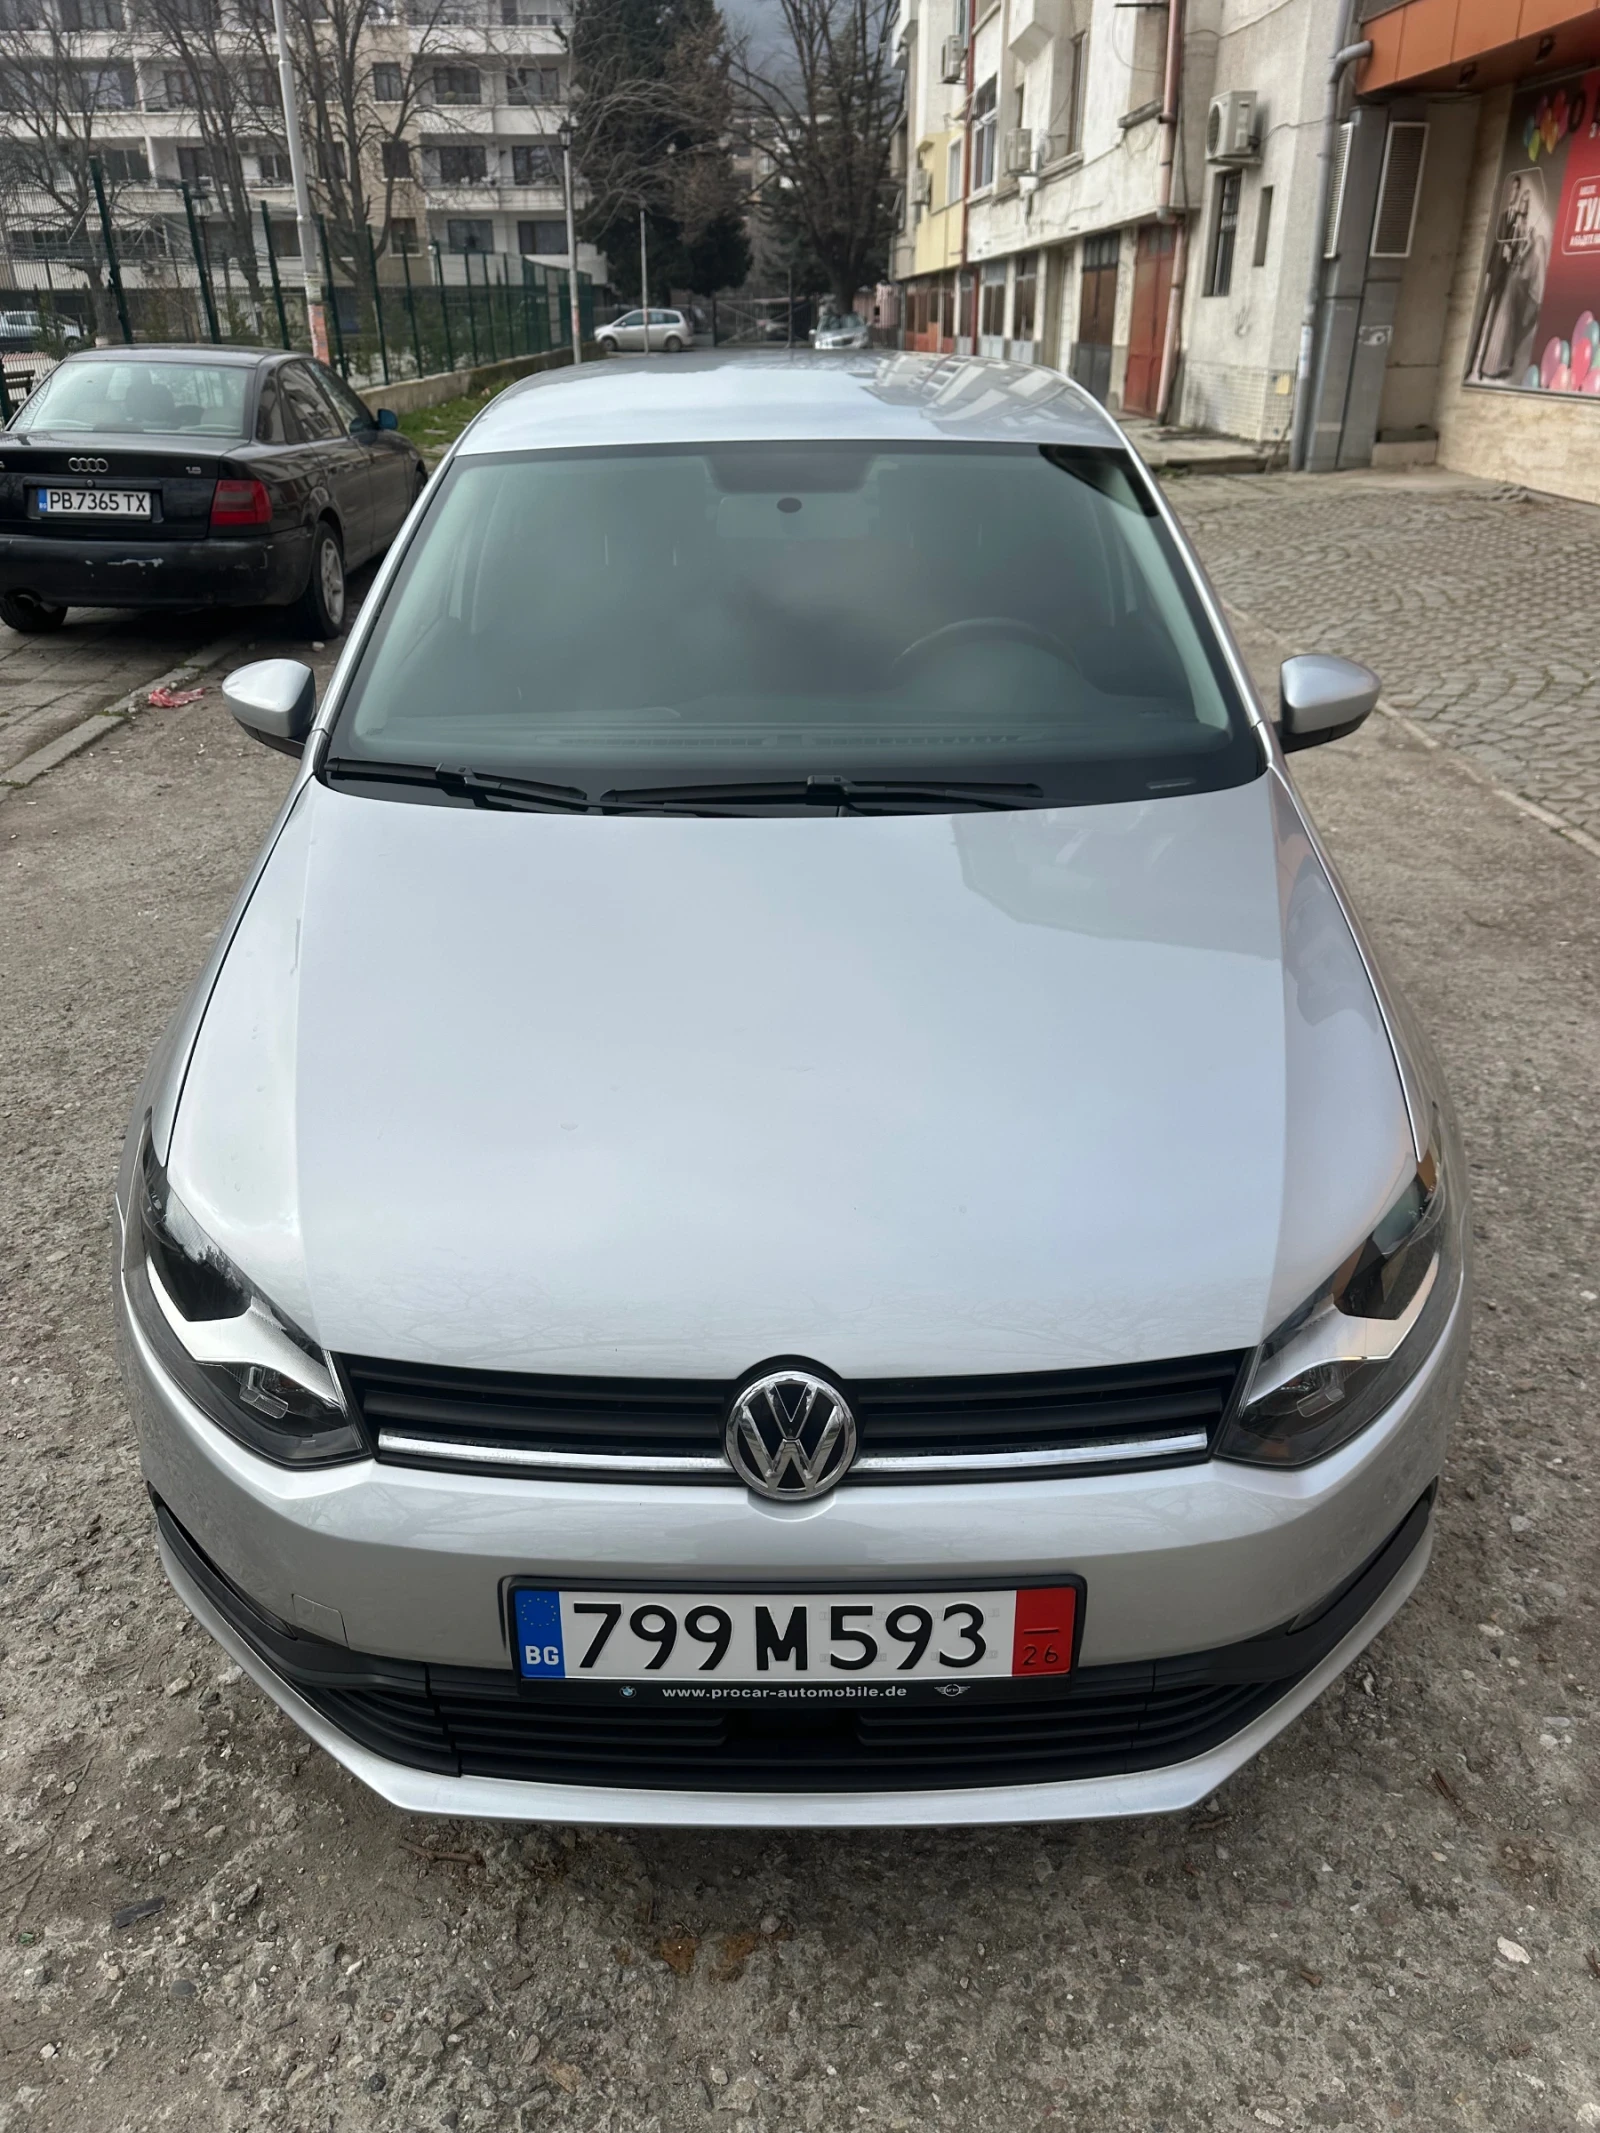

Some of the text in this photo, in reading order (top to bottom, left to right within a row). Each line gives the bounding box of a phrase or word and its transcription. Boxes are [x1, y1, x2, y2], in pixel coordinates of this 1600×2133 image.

[76, 493, 119, 511] 7365
[122, 494, 146, 512] TX
[573, 1602, 987, 1671] 799 M 593
[525, 1645, 560, 1665] BG
[1022, 1644, 1060, 1666] 26
[662, 1685, 908, 1700] www.procar-automobile.de
